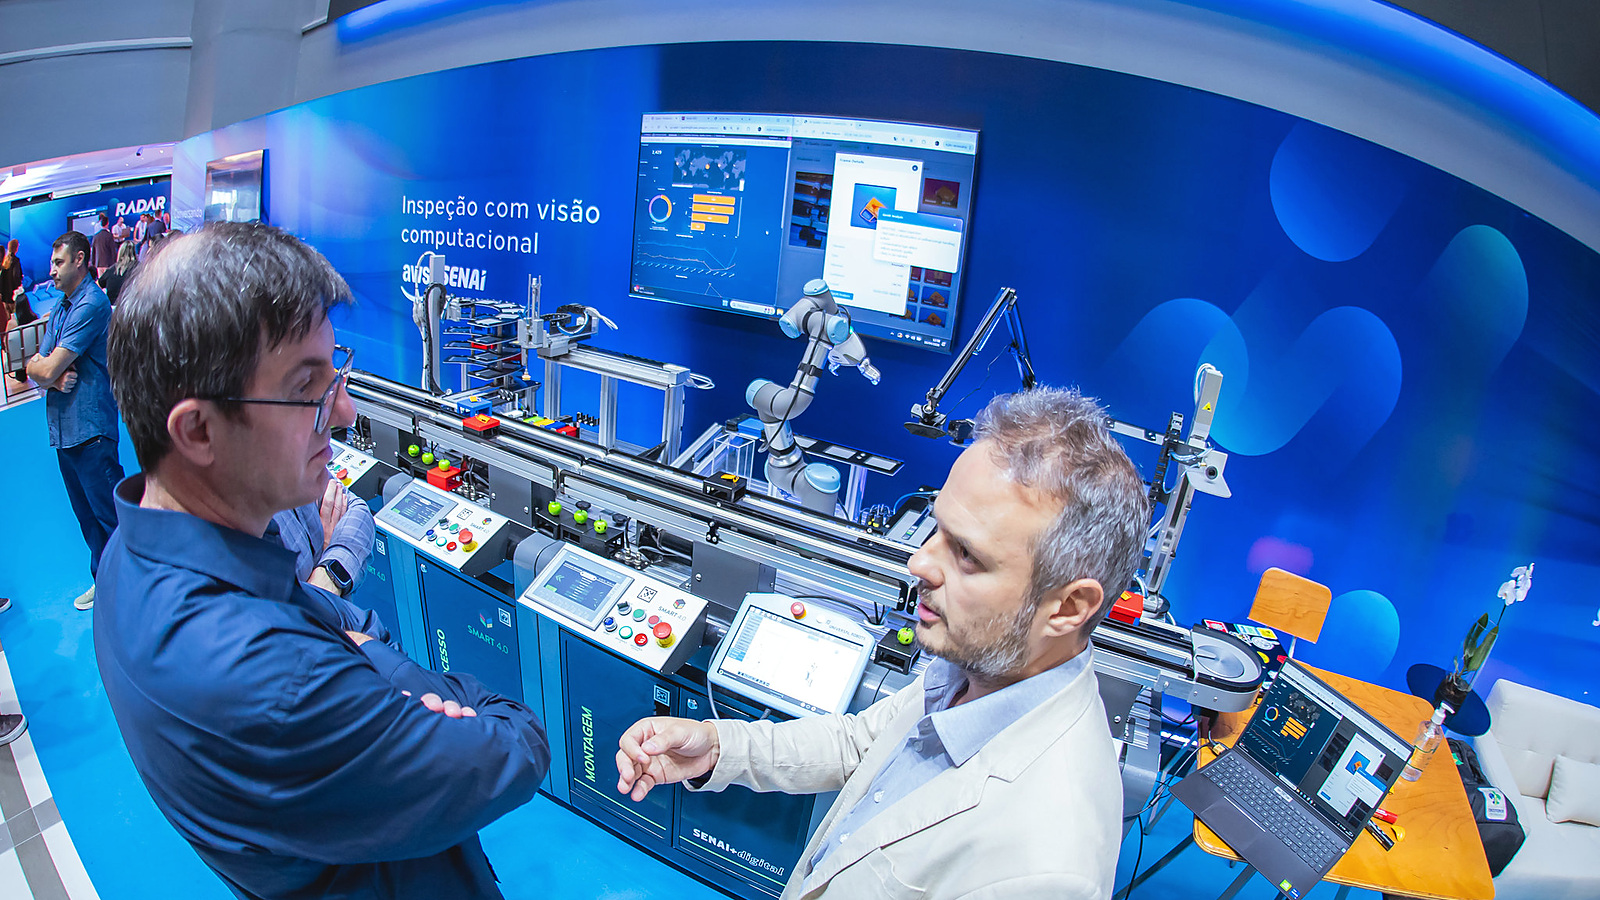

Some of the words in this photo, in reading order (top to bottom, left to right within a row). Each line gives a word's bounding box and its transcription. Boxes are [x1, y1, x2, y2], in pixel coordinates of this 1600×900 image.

[115, 195, 166, 217] RADAR
[402, 195, 478, 221] Inspeção
[484, 200, 529, 219] com
[537, 198, 600, 224] visão
[401, 228, 539, 255] computacional
[658, 606, 678, 618] SMART
[436, 628, 450, 673] CESSO
[467, 624, 495, 647] SMART
[496, 642, 509, 654] 4.0
[581, 705, 596, 783] MONTAGEM
